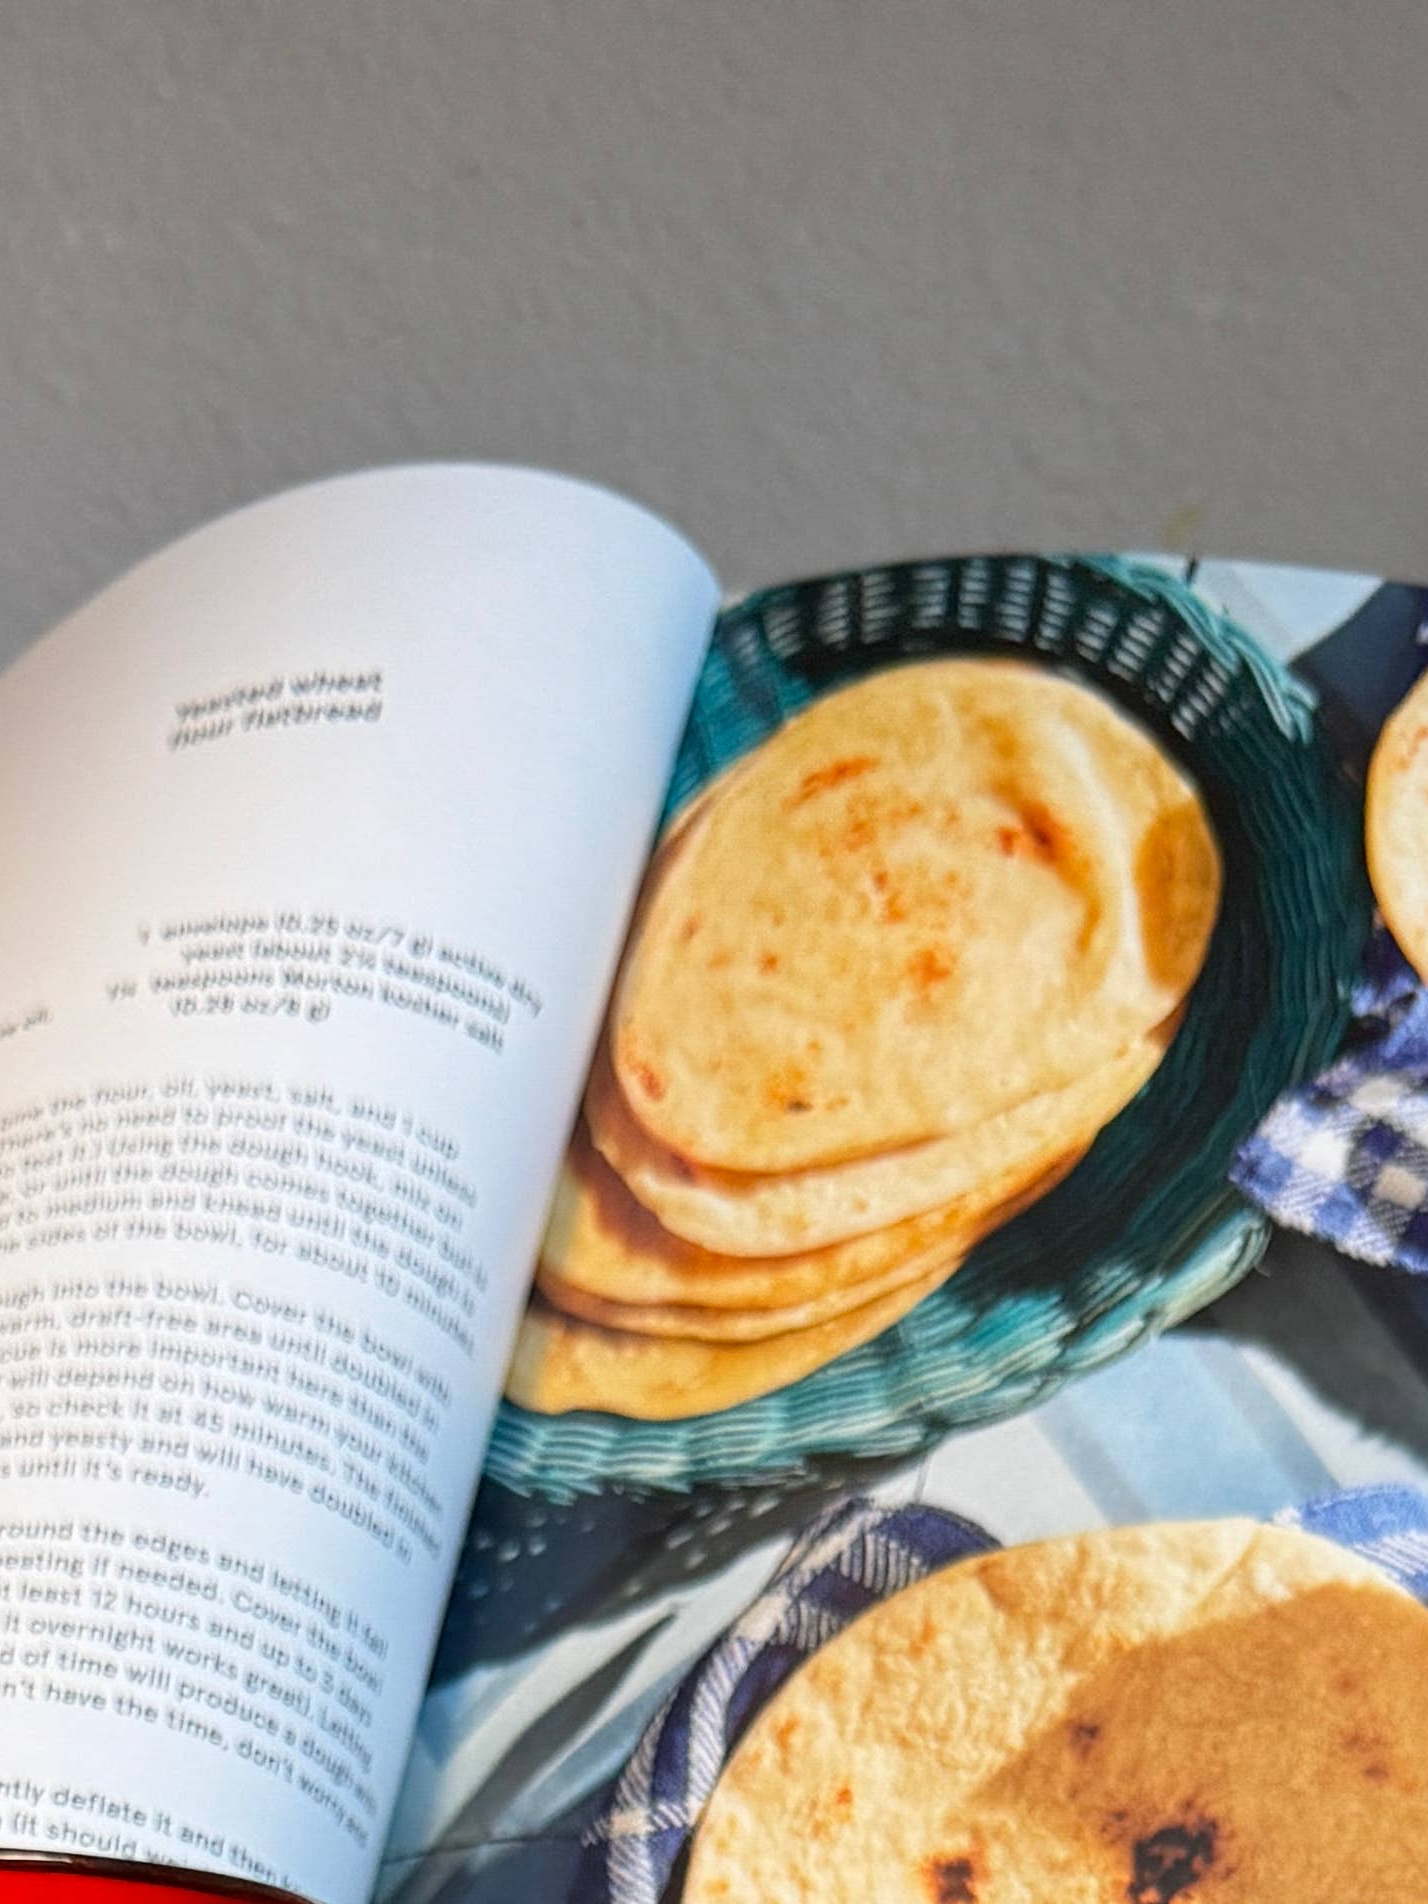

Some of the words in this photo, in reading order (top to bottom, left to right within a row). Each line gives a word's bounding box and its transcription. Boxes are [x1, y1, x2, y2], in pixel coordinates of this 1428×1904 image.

[291, 1110, 337, 1144] the
[349, 1096, 396, 1130] and
[112, 1163, 155, 1183] the
[158, 1162, 239, 1190] dough
[242, 1163, 330, 1205] comes
[177, 1130, 222, 1156] the
[225, 1136, 310, 1170] dough
[124, 1220, 169, 1240] the
[250, 1228, 289, 1256] for
[292, 1238, 370, 1285] about
[150, 1190, 197, 1212] and
[202, 1190, 282, 1225] knead
[285, 1200, 347, 1242] until
[350, 1222, 392, 1262] the
[105, 1278, 150, 1298] the
[232, 1288, 312, 1325] Cover
[314, 1308, 356, 1345] the
[205, 1318, 262, 1344] area
[269, 1327, 327, 1366] until
[7, 1367, 52, 1390] will
[54, 1365, 155, 1392] depend
[159, 1373, 197, 1393] on
[200, 1375, 257, 1410] how
[260, 1397, 332, 1440] warm
[75, 1338, 143, 1358] more
[150, 1338, 282, 1384] important
[285, 1363, 342, 1408] here
[9, 1398, 42, 1420] so
[47, 1395, 127, 1420] check
[130, 1398, 150, 1422] it
[155, 1400, 184, 1427] at
[0, 1425, 45, 1450] and
[48, 1425, 132, 1458] yeasty
[138, 1428, 190, 1458] and
[192, 1440, 242, 1472] will
[244, 1450, 307, 1495] have
[308, 1480, 394, 1553] doubled
[17, 1455, 77, 1480] until
[82, 1455, 123, 1482] it's
[129, 1465, 212, 1500] ready.
[80, 1524, 126, 1547] the
[131, 1533, 210, 1563] edges
[216, 1550, 266, 1584] and
[272, 1567, 342, 1630] letting
[90, 1555, 115, 1577] if
[118, 1560, 224, 1605] needed.
[230, 1590, 302, 1637] Cover
[305, 1620, 342, 1663] the
[2, 1608, 22, 1634] it
[26, 1612, 156, 1654] overnight
[160, 1637, 240, 1680] works
[19, 1582, 83, 1606] least
[90, 1586, 120, 1610] 12
[124, 1592, 202, 1632] hours
[204, 1614, 256, 1650] and
[260, 1638, 292, 1668] up
[293, 1650, 319, 1684] to
[22, 1645, 52, 1670] of
[57, 1650, 120, 1680] time
[124, 1660, 172, 1695] will
[175, 1680, 279, 1737] produce
[283, 1725, 297, 1747] a
[42, 1682, 107, 1712] have
[114, 1693, 160, 1725] the
[166, 1705, 228, 1752] time,
[232, 1740, 294, 1787] don't
[44, 1818, 139, 1852] should
[50, 1788, 149, 1828] deflate
[153, 1807, 174, 1838] it
[179, 1820, 226, 1860] and
